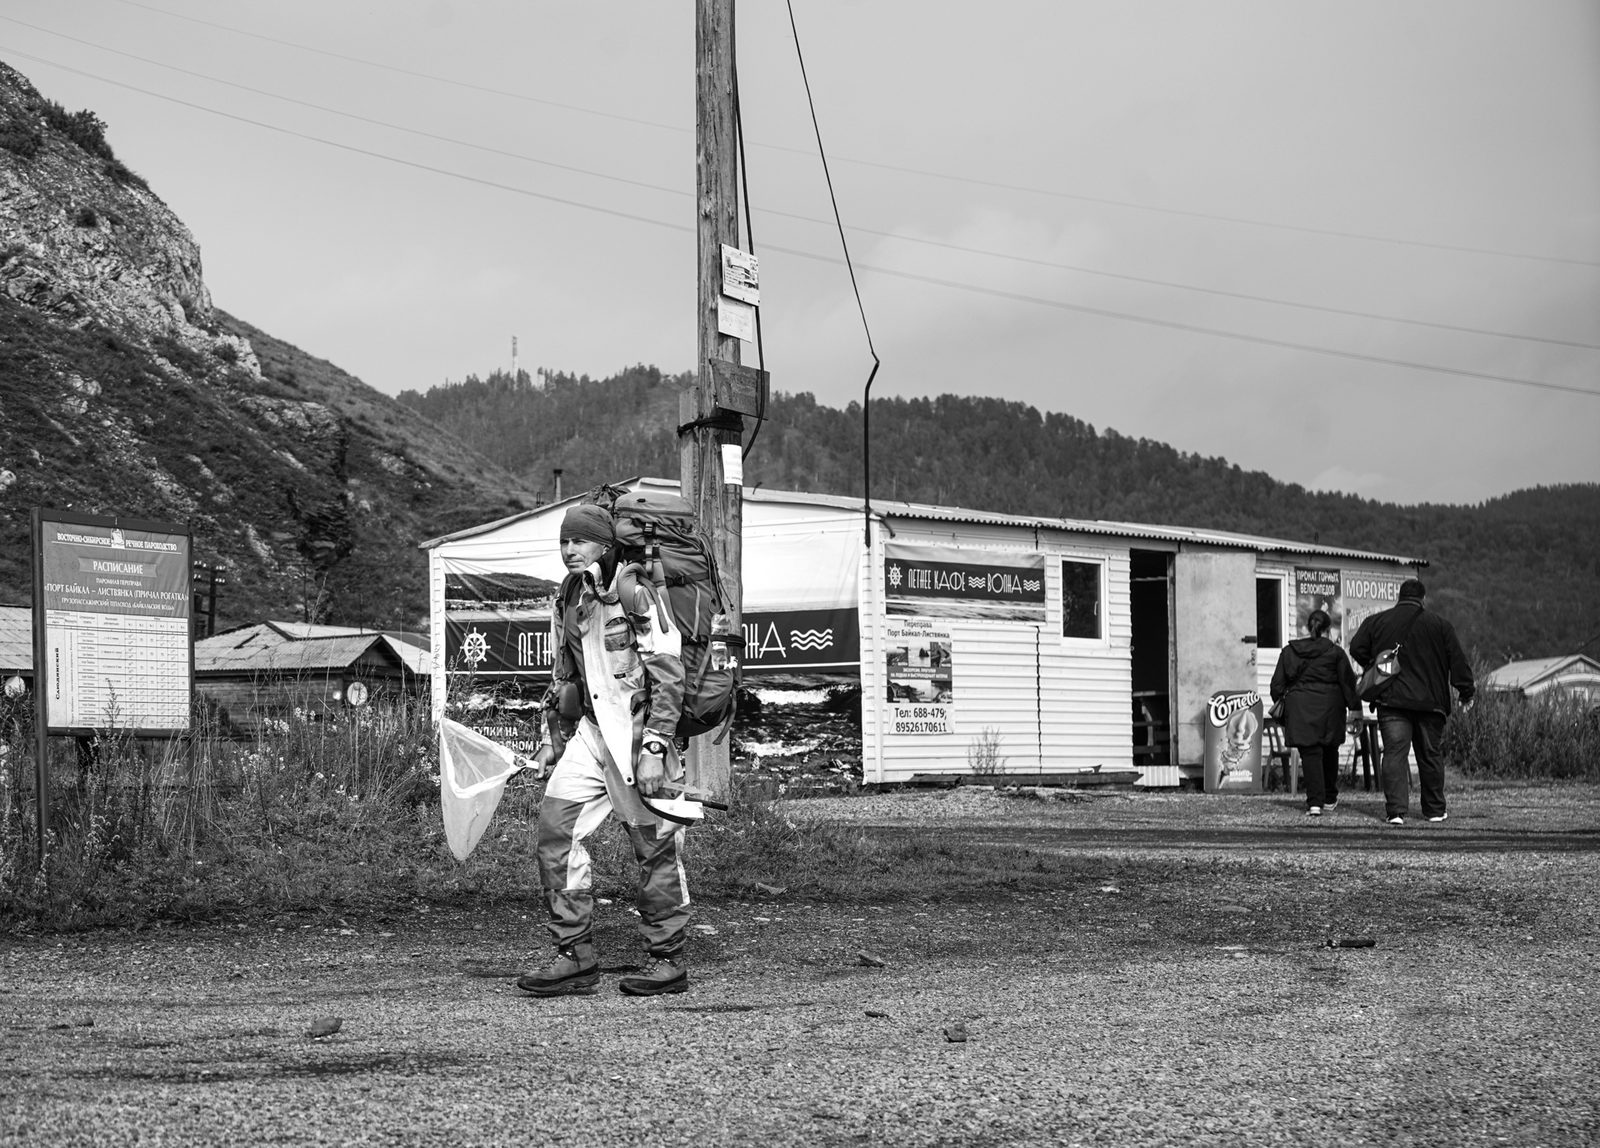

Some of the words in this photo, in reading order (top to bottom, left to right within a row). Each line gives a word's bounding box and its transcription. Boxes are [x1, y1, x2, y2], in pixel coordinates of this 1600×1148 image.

[57, 532, 111, 546] ВОСТОЧНО-СИБИРСКОЕ
[125, 539, 144, 549] РЕЧНОЕ
[92, 560, 144, 575] РАСПИСАНИЕ
[908, 568, 932, 590] ЛЕТНЕЕ
[934, 570, 966, 592] КАФЕ
[987, 572, 1023, 595] ВОЛНА
[1296, 569, 1317, 582] ПРОКАТ
[1318, 570, 1340, 583] ГОРНЫХ
[65, 582, 90, 595] БАЙКАЛ
[97, 587, 133, 598] ЛИСТВЯНКА
[1300, 582, 1336, 597] ВЕЛОСИПЕДОВ
[1346, 579, 1401, 601] МОРОЖЕН
[887, 629, 901, 638] Порт
[518, 632, 553, 666] ЛЕТН
[894, 707, 912, 718] Тел:
[913, 707, 947, 721] 688-479;
[1208, 690, 1260, 727] Cornetto
[505, 726, 519, 738] НА
[895, 721, 947, 733] 89526170611
